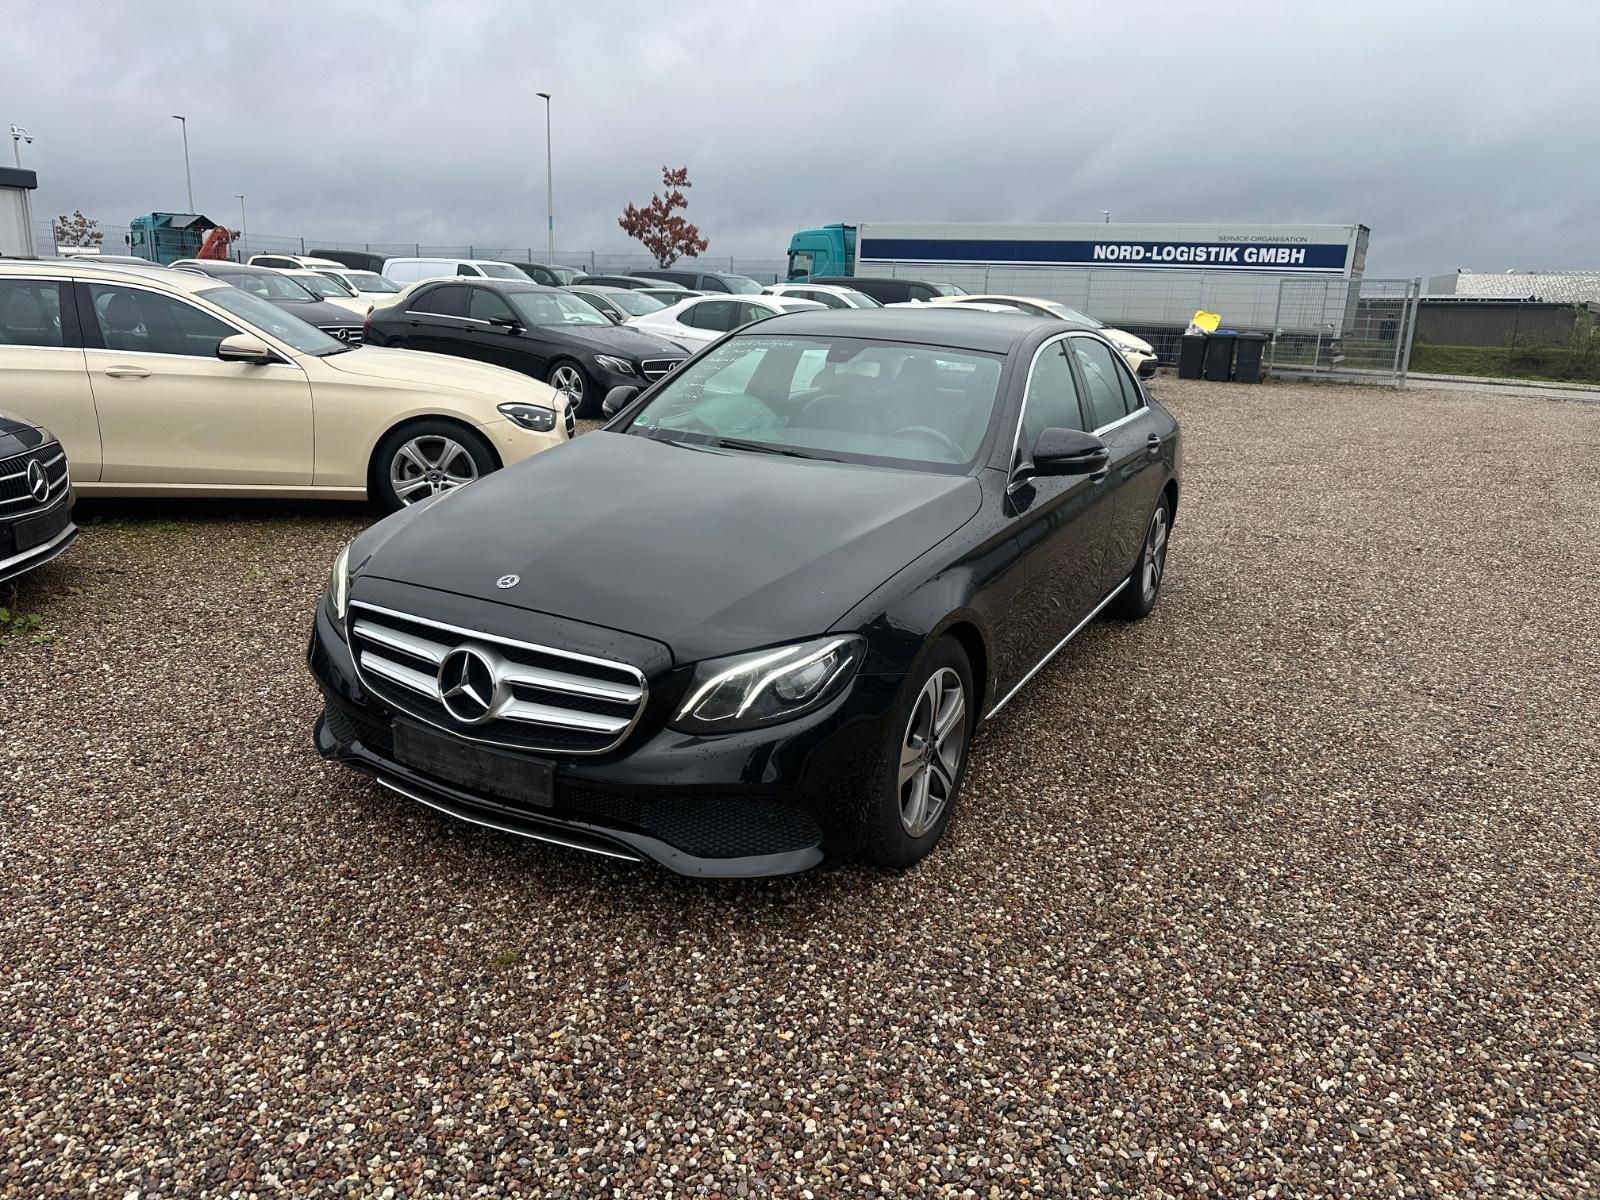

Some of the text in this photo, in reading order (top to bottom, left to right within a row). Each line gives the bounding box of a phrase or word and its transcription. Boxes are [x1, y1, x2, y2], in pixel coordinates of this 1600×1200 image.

[1218, 235, 1308, 243] SERVICE-ORGANISATION
[1093, 245, 1306, 264] NORD-LOGISTIK GMBH
